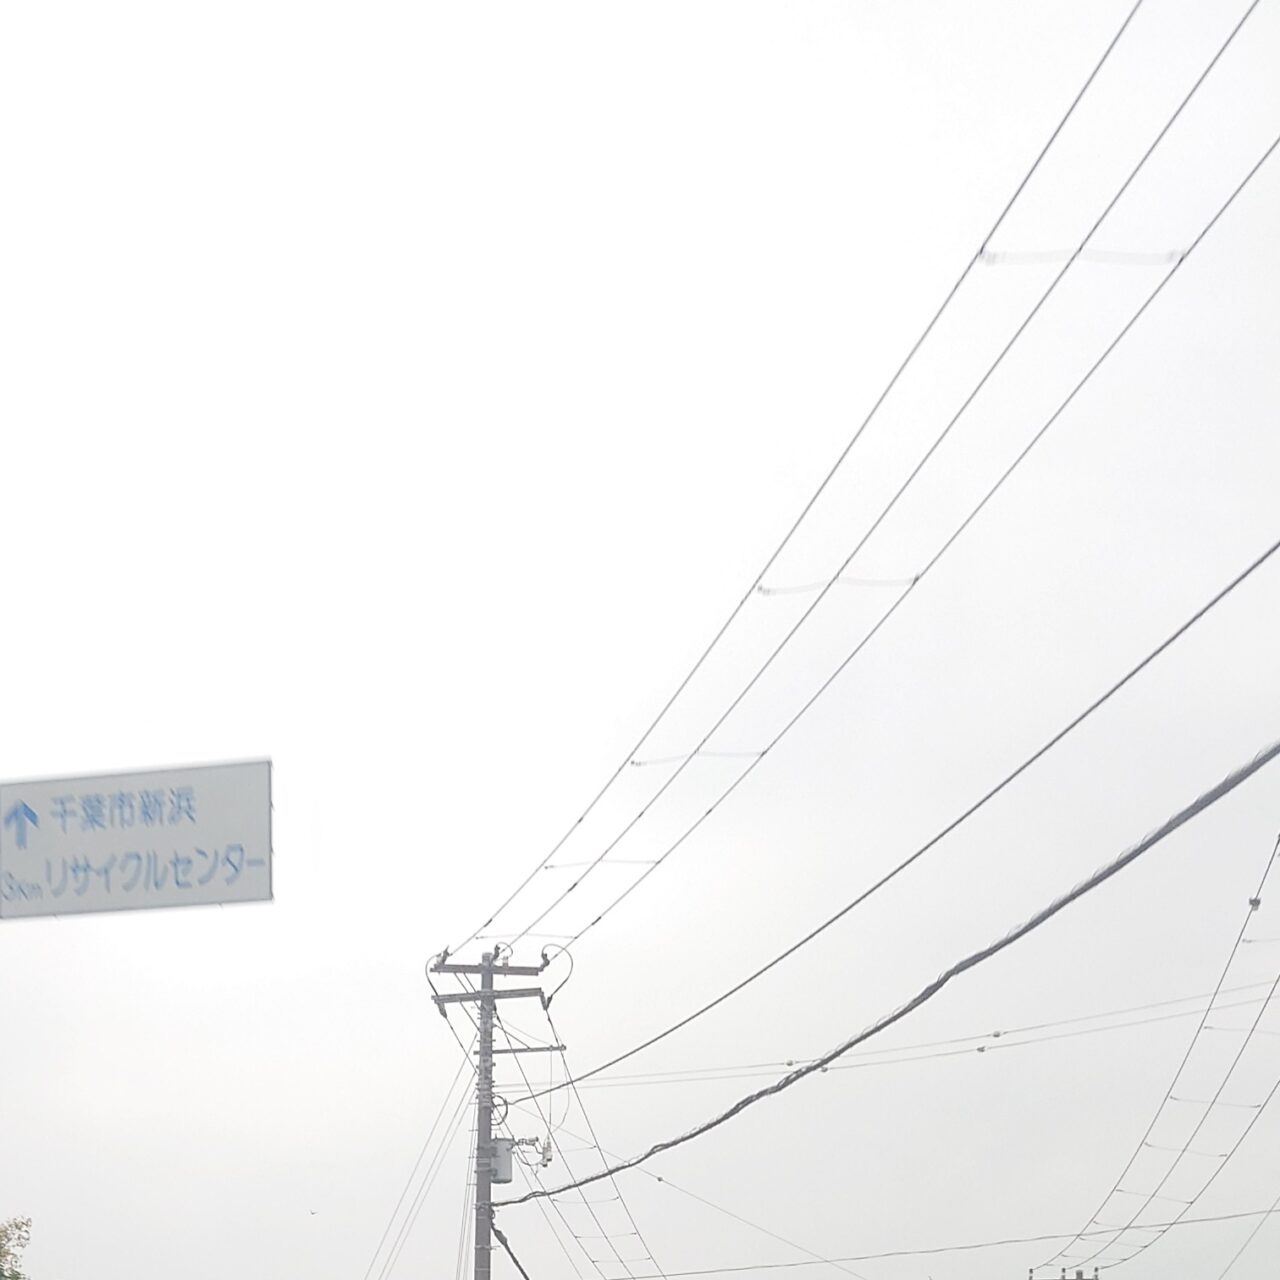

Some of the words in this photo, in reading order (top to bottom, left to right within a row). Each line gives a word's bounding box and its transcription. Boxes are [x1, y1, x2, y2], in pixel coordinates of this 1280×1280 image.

[45, 843, 266, 897] リサイクルセンター
